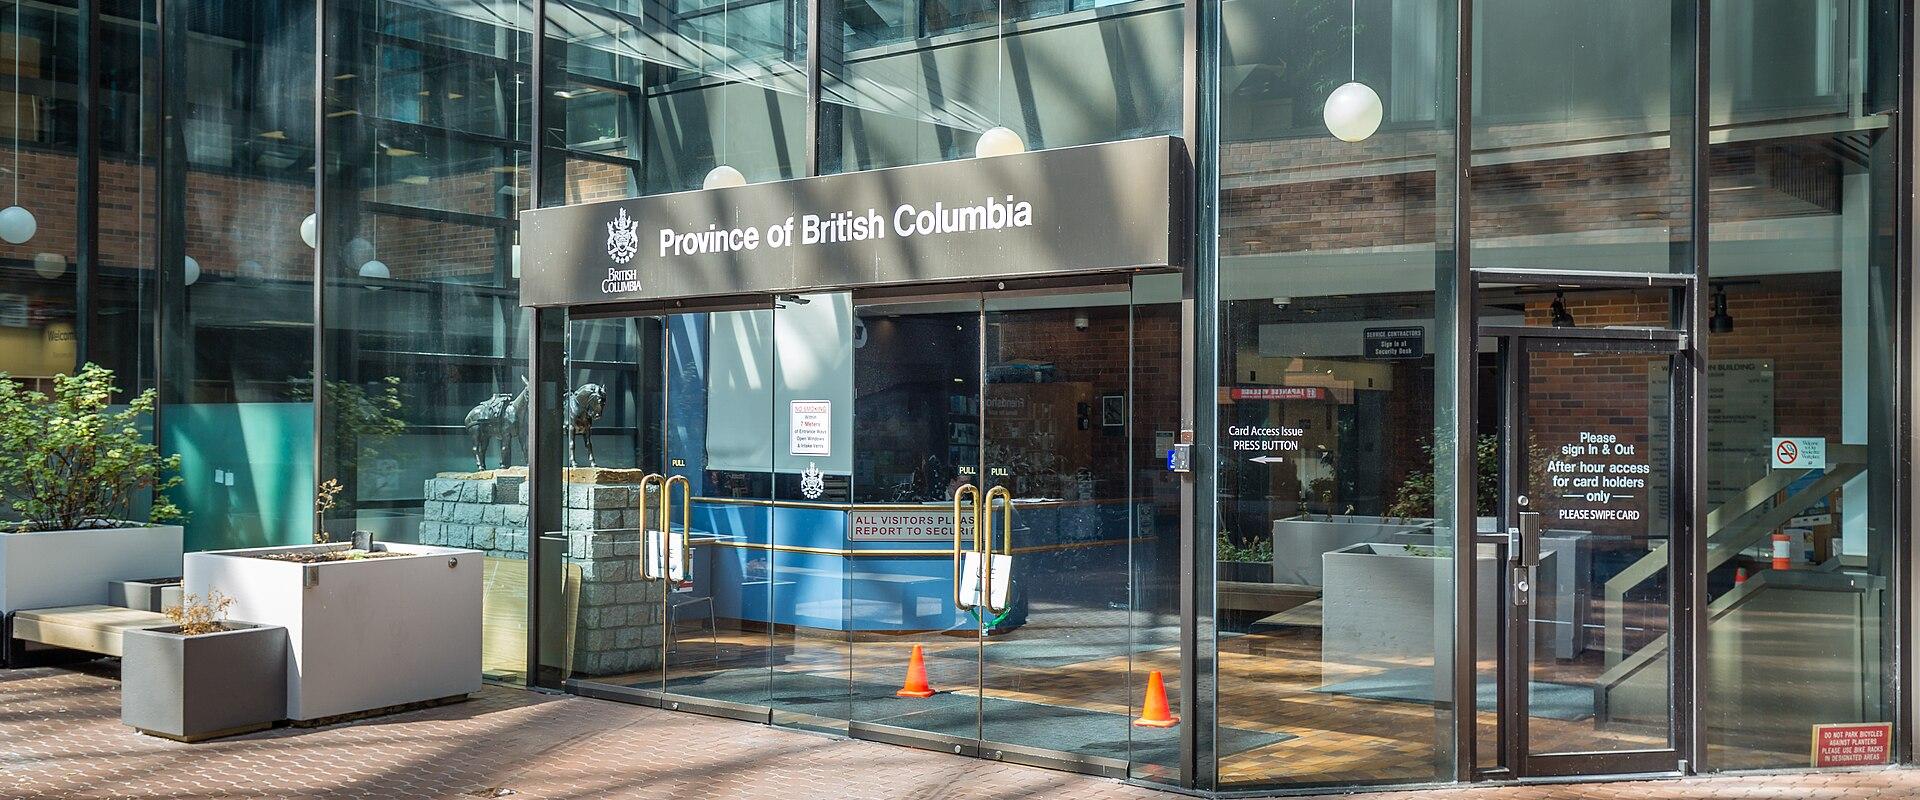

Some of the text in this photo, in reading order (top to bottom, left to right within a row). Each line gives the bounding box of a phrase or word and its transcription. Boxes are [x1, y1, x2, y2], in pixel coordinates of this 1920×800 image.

[659, 194, 1033, 258] Province of British Columbia
[608, 267, 637, 281] BRITISH
[601, 279, 642, 294] COLUMBIA
[1717, 363, 1756, 371] BUILDING
[1228, 426, 1303, 436] Card Access Issue
[1580, 432, 1616, 443] Please
[1233, 440, 1298, 450] PRESS BUTTON
[1562, 444, 1585, 457] sign
[1602, 444, 1610, 455] &
[1614, 444, 1634, 455] Out
[672, 459, 685, 467] PULL
[1547, 461, 1650, 474] After hour access
[959, 466, 976, 475] PULL
[991, 467, 1008, 476] PULL
[1552, 475, 1644, 488] for card holders
[1586, 490, 1610, 504] only
[1559, 510, 1640, 520] PLEASE SWIPE CARD
[855, 516, 877, 525] ALL
[881, 516, 934, 525] VISITORS
[855, 527, 975, 536] REPORT TO SECURIT
